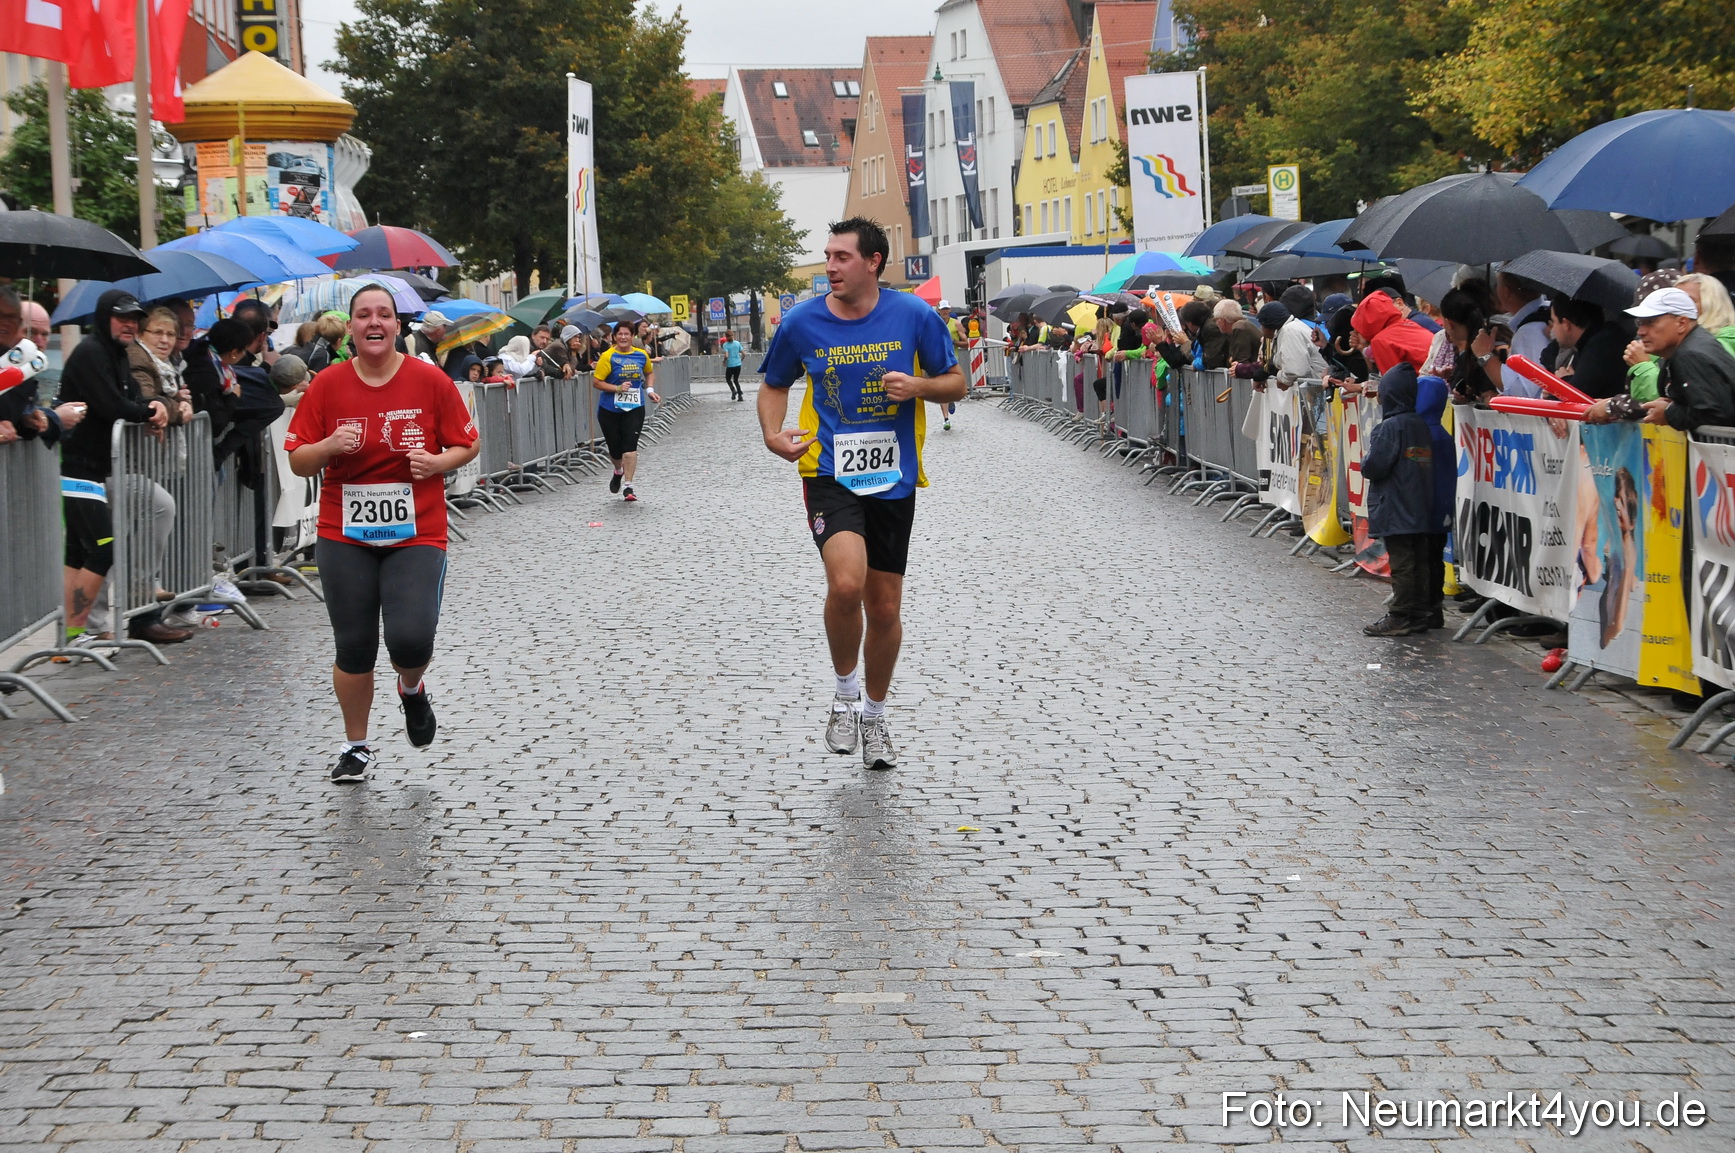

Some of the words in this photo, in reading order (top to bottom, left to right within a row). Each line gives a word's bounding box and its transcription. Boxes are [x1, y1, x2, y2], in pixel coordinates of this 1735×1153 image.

[675, 303, 685, 316] D
[814, 348, 828, 359] 10.
[828, 340, 902, 357] NEUMARKTER
[827, 351, 889, 366] STADTLAUF
[617, 392, 639, 403] 2776
[385, 414, 416, 422] STADTLAUF
[835, 438, 858, 447] PARTL
[859, 437, 891, 446] Neumarkt
[841, 446, 895, 474] 2384
[850, 475, 888, 489] Christian
[366, 489, 401, 497] Neumarkt
[349, 498, 408, 524] 2306
[362, 529, 397, 539] Kathrin
